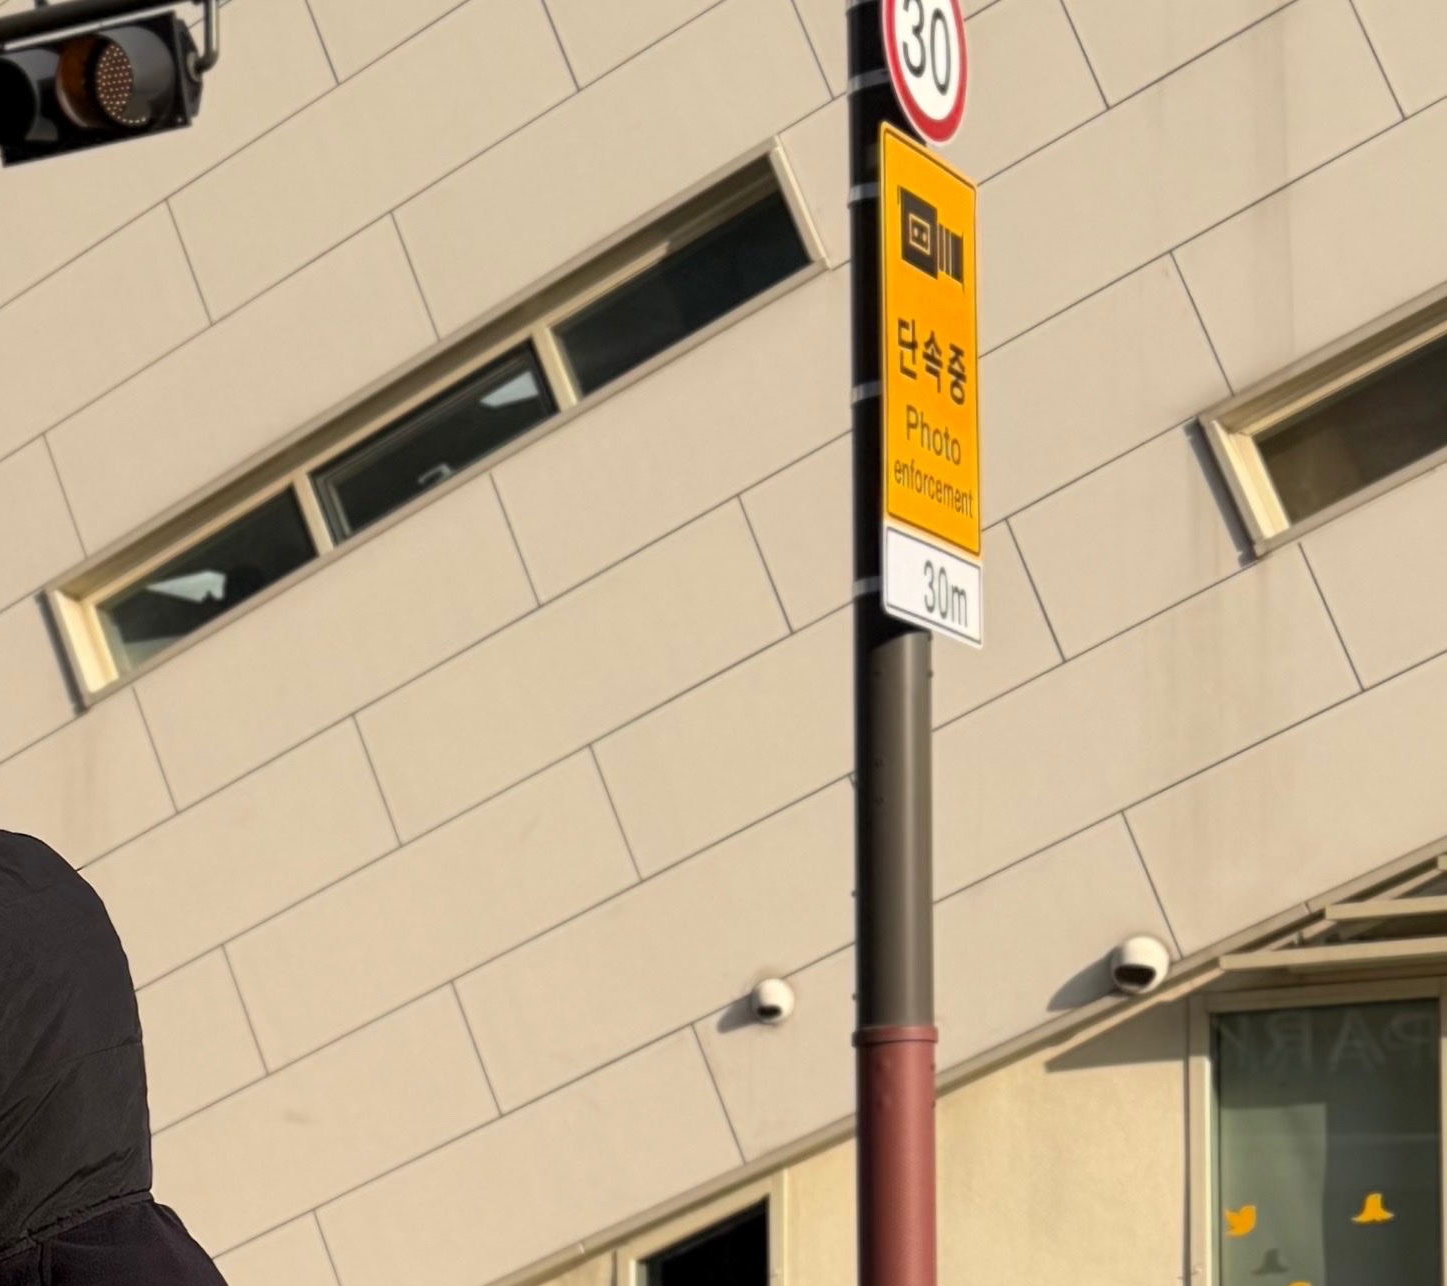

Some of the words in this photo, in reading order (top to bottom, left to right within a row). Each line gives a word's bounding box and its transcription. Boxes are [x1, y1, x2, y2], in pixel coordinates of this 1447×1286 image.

[902, 0, 951, 96] 30
[896, 318, 968, 406] 단속중
[905, 404, 963, 467] Photo
[893, 458, 974, 520] enforcement
[922, 558, 969, 630] 30m
